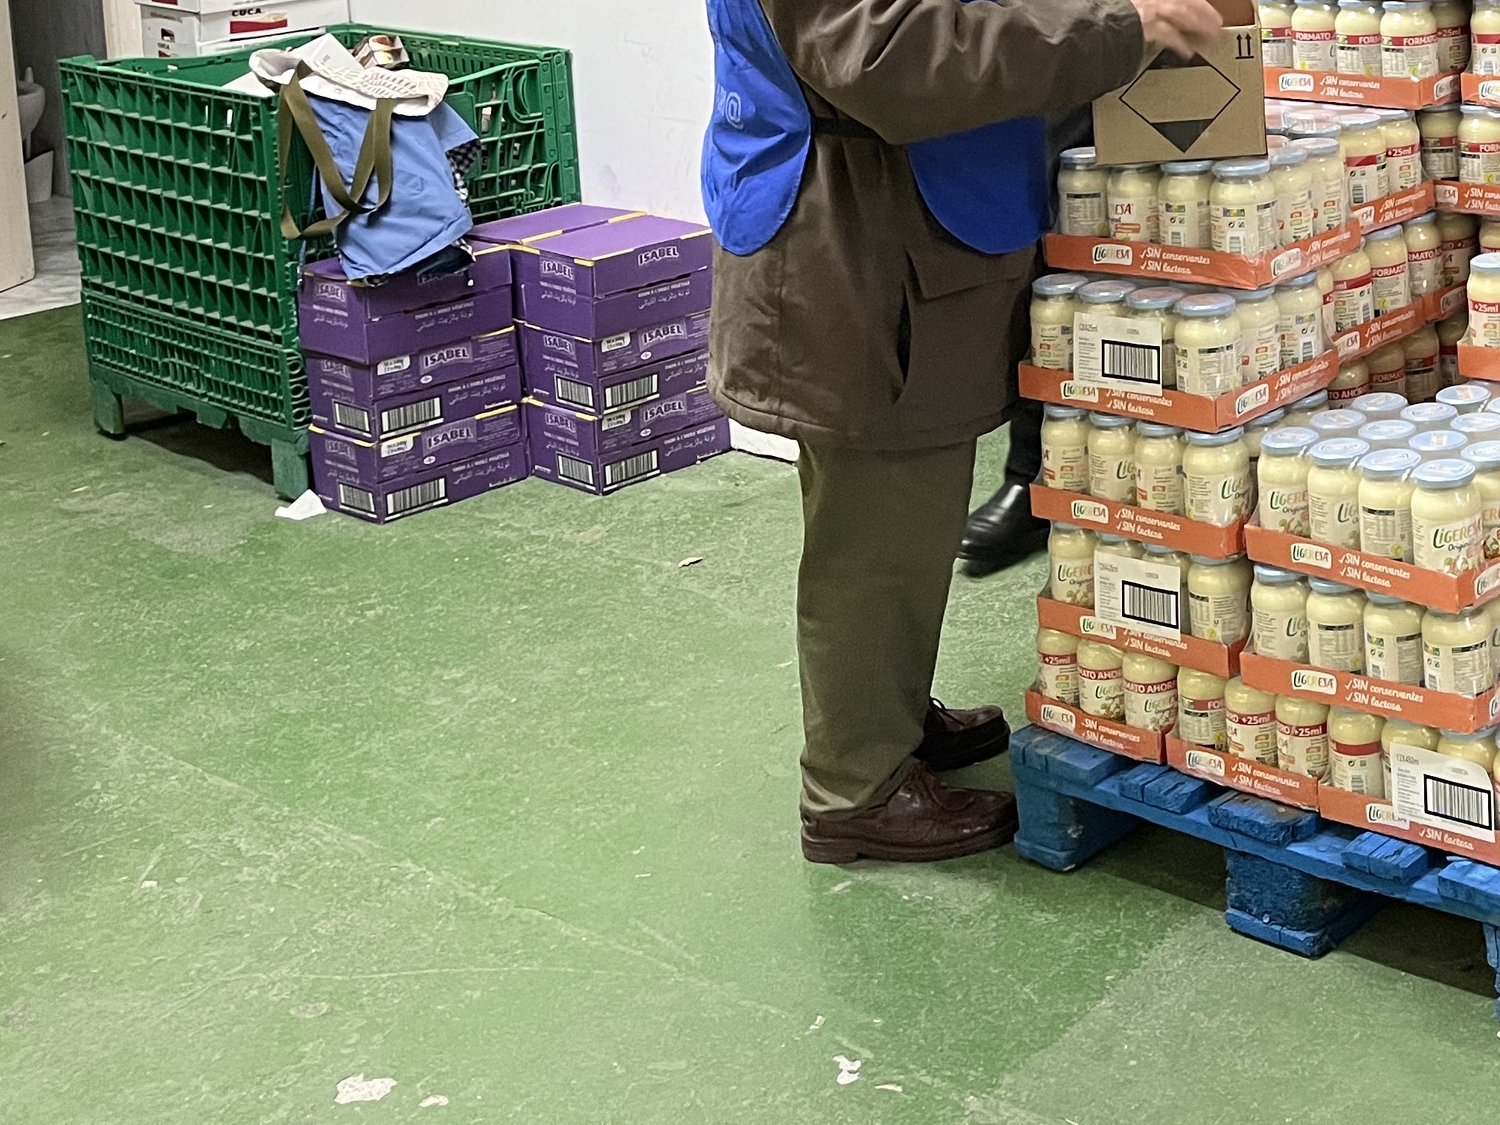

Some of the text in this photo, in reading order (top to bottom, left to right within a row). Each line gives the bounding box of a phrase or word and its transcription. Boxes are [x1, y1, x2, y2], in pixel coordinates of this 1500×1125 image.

[231, 7, 262, 17] CUCA
[1296, 31, 1331, 41] FORMATO
[1325, 76, 1380, 89] SIN conservantes
[1326, 87, 1364, 98] SIN lactosa
[1387, 147, 1412, 156] +25ml
[638, 247, 679, 265] ISABEL
[1146, 248, 1210, 264] SIN conservantes
[543, 260, 574, 280] ISABEL
[1146, 262, 1192, 274] SIN lactosa
[1474, 304, 1499, 313] +25ml
[643, 325, 683, 343] ISABEL
[424, 348, 469, 367] ISABEL
[643, 401, 684, 422] ISABEL
[1112, 400, 1154, 416] SIN lactosa
[427, 427, 473, 447] ISABEL
[1121, 509, 1181, 531] SIN conservantes
[1121, 522, 1163, 539] SIN lactosa
[1345, 553, 1410, 579] SIN conservantes
[1346, 566, 1391, 587] SIN lactosa
[1130, 638, 1171, 657] SIN lactosa
[1045, 656, 1071, 665] +25ml
[1352, 679, 1424, 702] SIN conservantes
[1353, 692, 1402, 711] SIN lactosa
[1242, 715, 1271, 724] +25ml
[1294, 727, 1322, 736] +25ml
[1238, 762, 1300, 789] SIN conservantes
[1427, 829, 1475, 851] SIN lactosa
